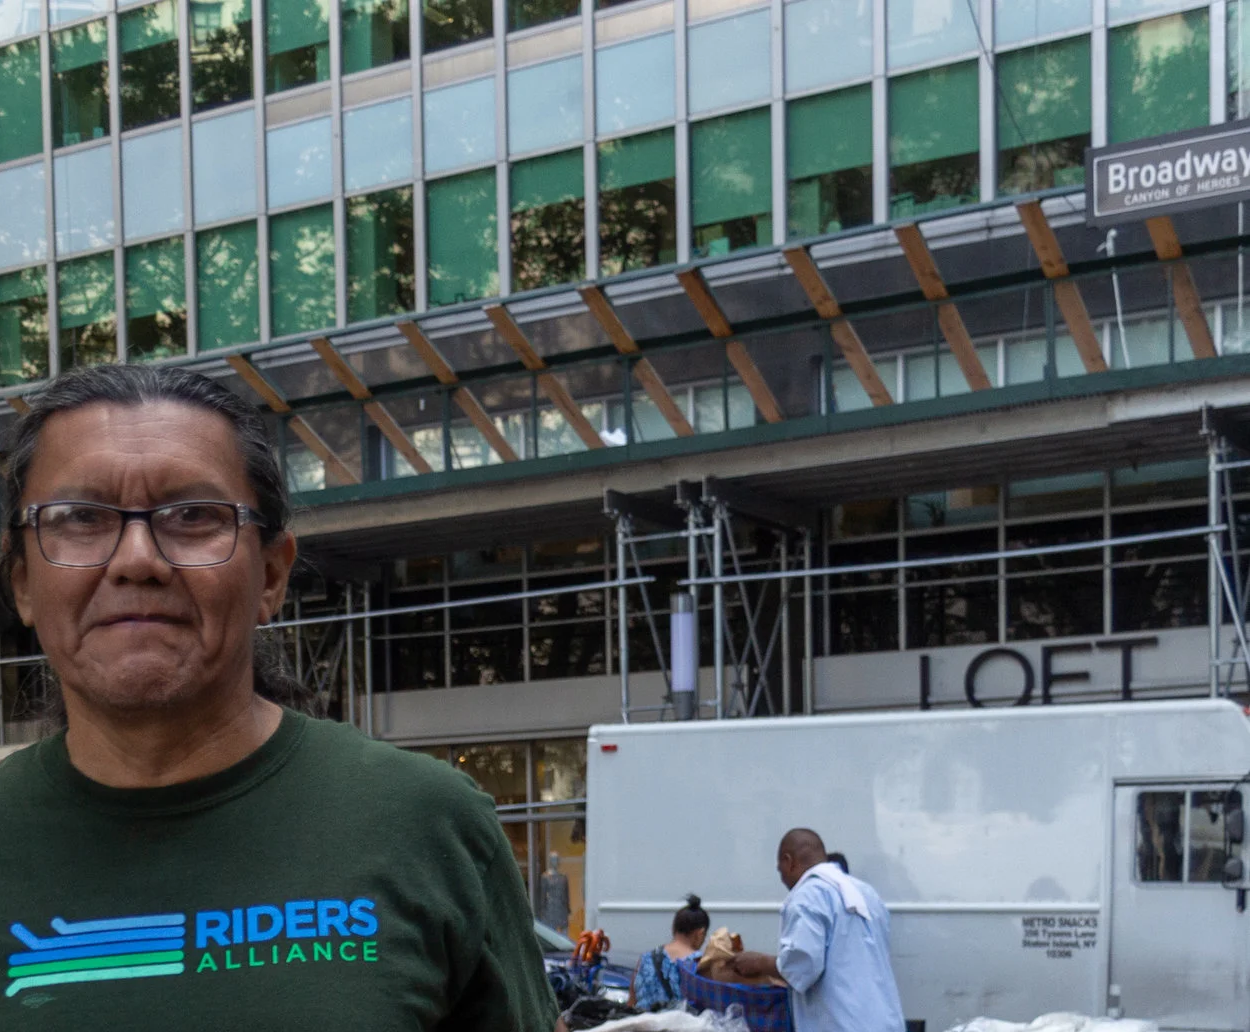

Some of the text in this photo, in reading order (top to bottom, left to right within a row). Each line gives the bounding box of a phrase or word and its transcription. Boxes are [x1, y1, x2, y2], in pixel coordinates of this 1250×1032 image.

[1107, 147, 1250, 195] Broadway
[1123, 174, 1241, 206] CANYON OF HEROES
[919, 636, 1159, 711] LOFT
[195, 896, 380, 949] RIDERS
[1021, 916, 1056, 928] METRO
[195, 940, 380, 974] ALLIANCE
